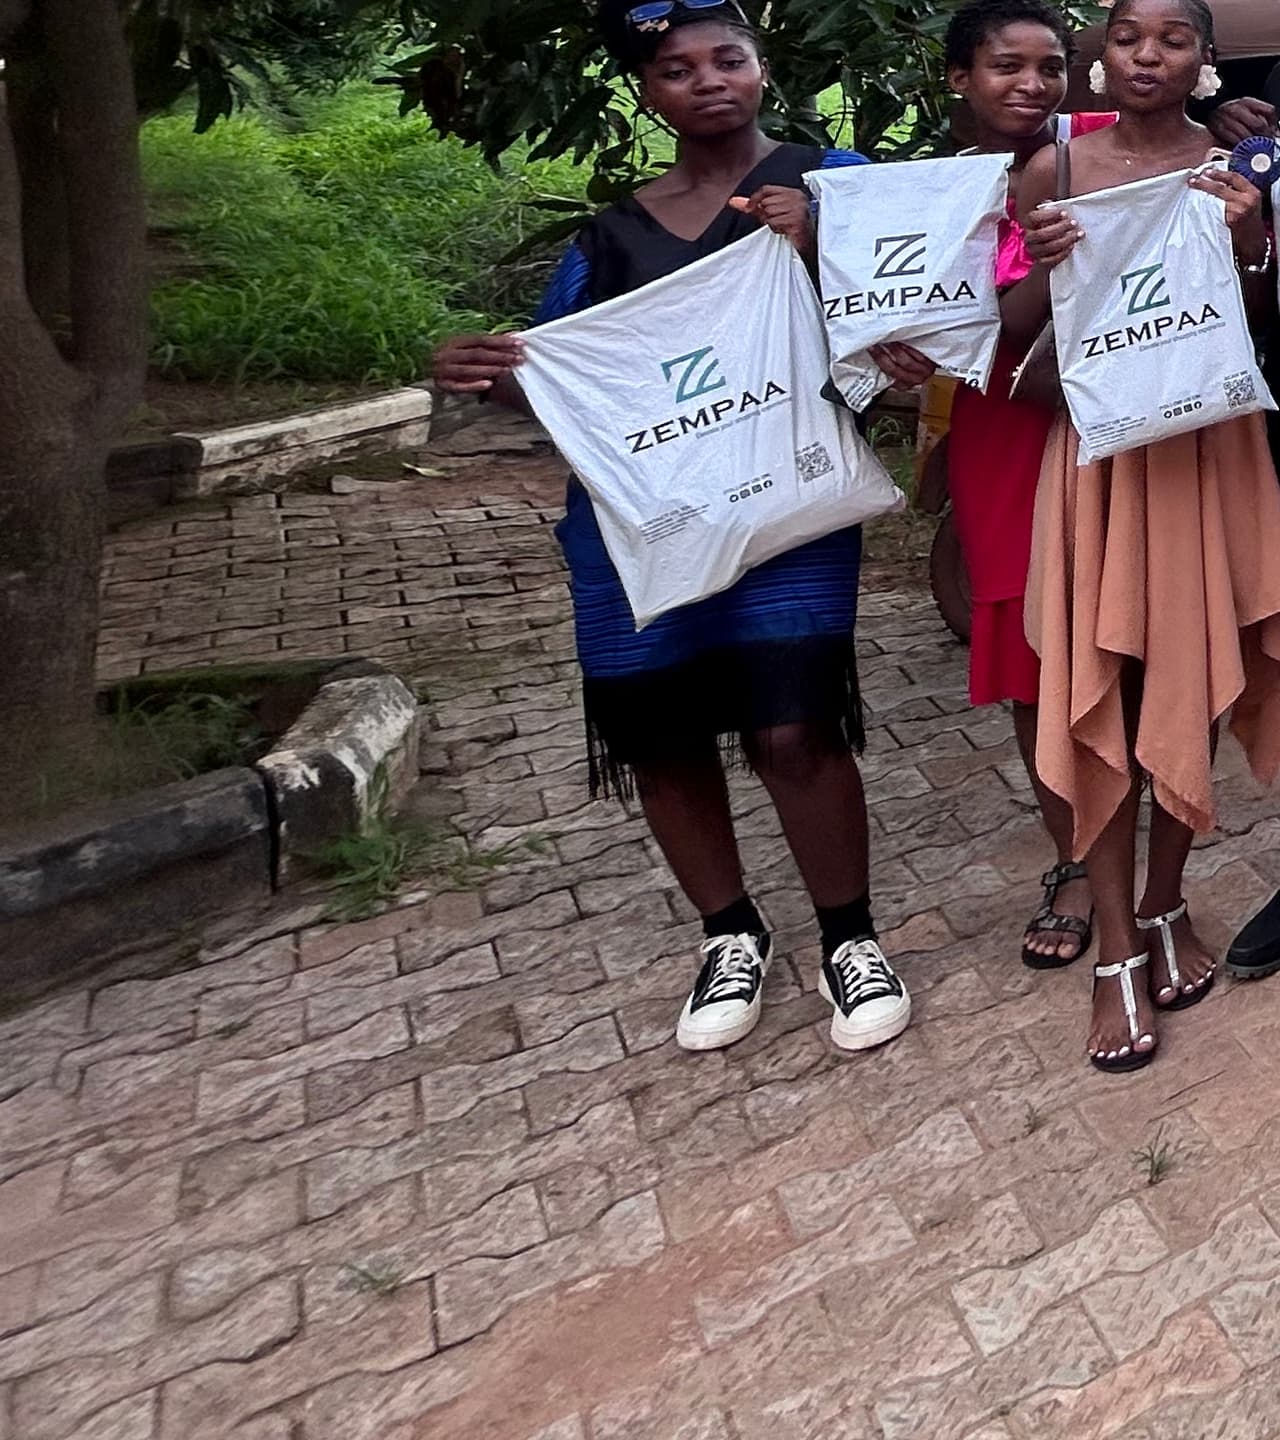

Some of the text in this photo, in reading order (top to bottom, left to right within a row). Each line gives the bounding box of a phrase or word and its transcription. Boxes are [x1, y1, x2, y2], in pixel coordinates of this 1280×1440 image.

[823, 280, 977, 320] ZEMPAA
[1081, 303, 1222, 359] ZEMPAA
[625, 380, 787, 455] ZEMPAA
